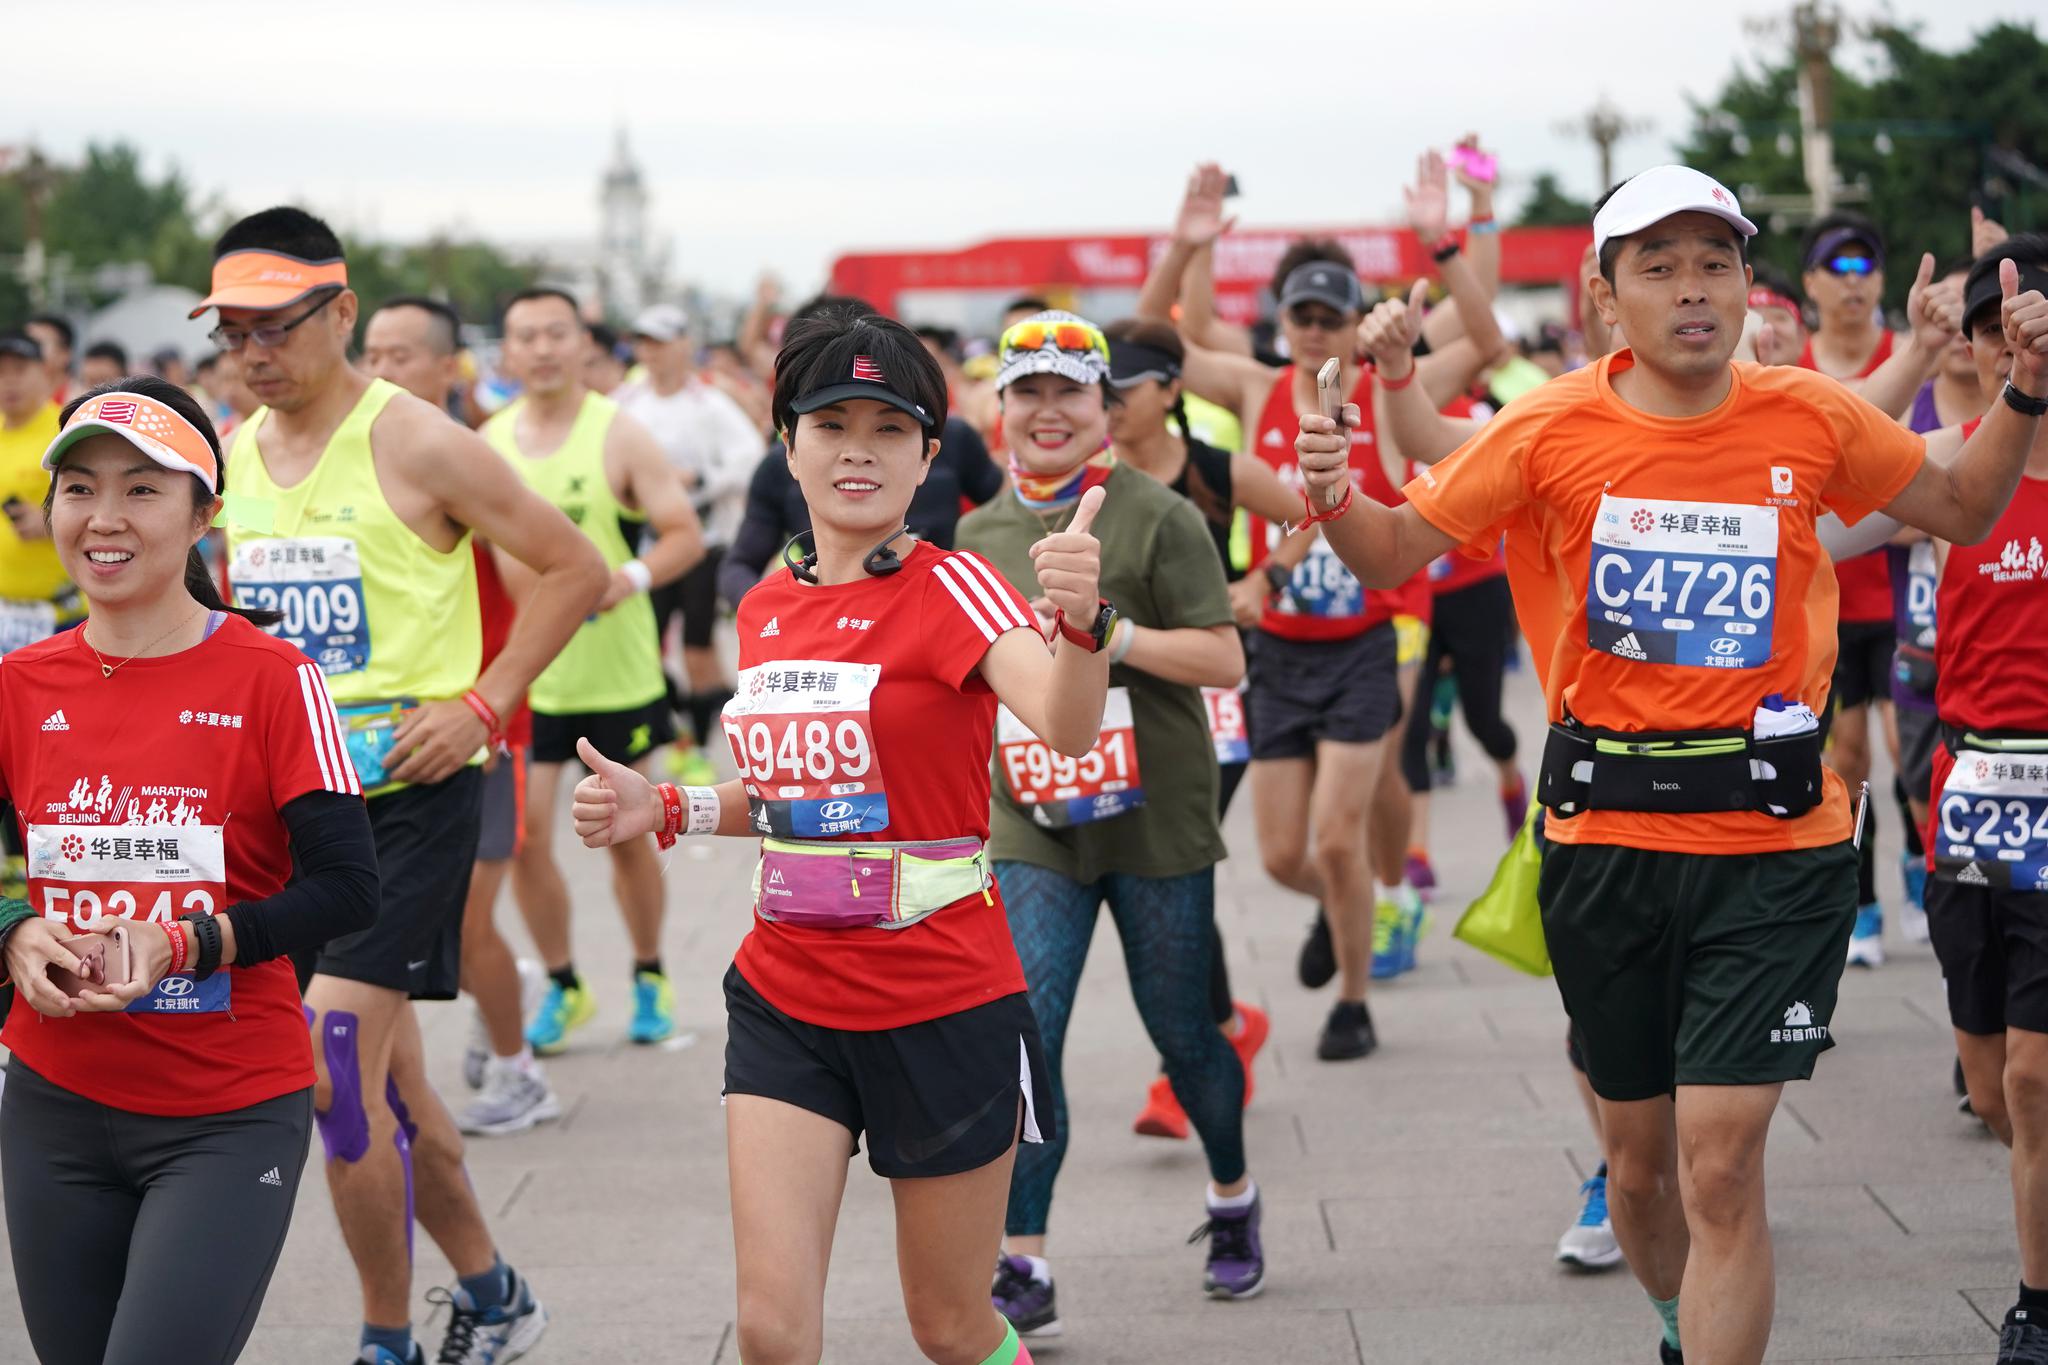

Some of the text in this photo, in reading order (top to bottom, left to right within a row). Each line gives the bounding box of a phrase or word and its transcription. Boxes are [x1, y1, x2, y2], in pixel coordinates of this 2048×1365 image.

[1660, 512, 1742, 536] 华夏幸福
[1978, 562, 2000, 574] 2018
[1993, 570, 2033, 582] BEIJING
[1595, 553, 1771, 619] C4726
[760, 628, 780, 638] adidas
[1611, 644, 1647, 661] adidas
[1704, 656, 1744, 668] 北京现代
[766, 671, 839, 692] 华夏幸福
[195, 711, 243, 729] 华夏幸福
[41, 722, 70, 731] adidas
[723, 719, 871, 781] D9489
[1653, 781, 1681, 790] hoco.
[68, 775, 113, 814] 北京
[141, 786, 208, 798] MARATHON
[46, 802, 67, 813] 2018
[59, 813, 100, 823] BEIJING
[819, 820, 861, 833] 北京现代
[91, 837, 179, 861] 华夏幸福
[154, 998, 200, 1010] 北京现代
[259, 1175, 282, 1187] adidas
